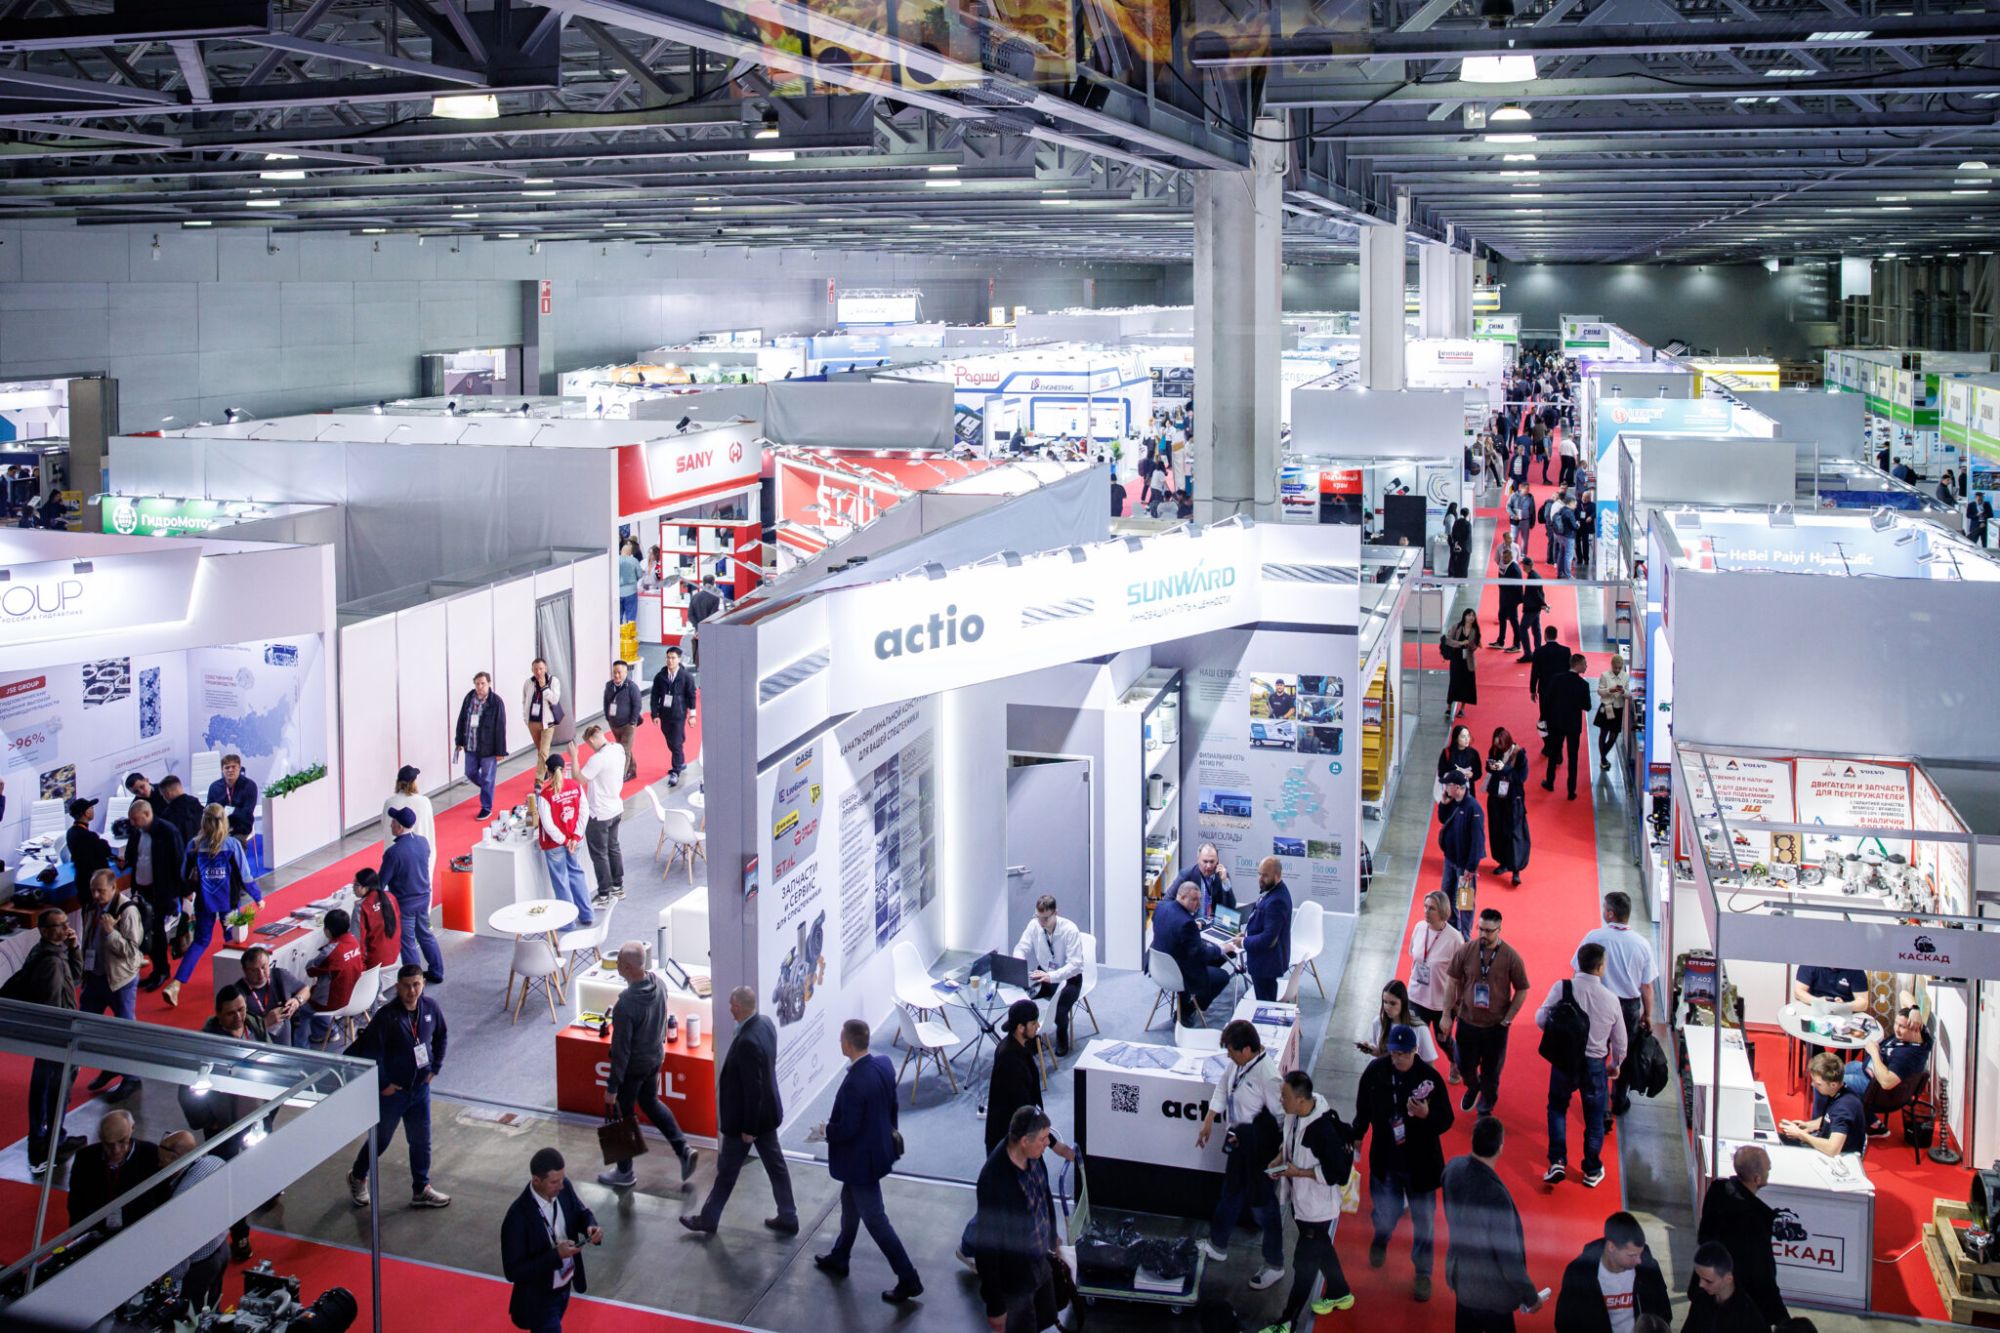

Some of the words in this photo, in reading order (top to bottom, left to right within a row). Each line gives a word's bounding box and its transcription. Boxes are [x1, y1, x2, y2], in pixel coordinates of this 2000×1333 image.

[676, 449, 713, 474] SANY
[1730, 549, 1768, 561] HeBei
[1773, 550, 1805, 566] Paiyi
[1127, 558, 1236, 606] SUNWARD
[874, 603, 985, 661] actio
[795, 747, 813, 767] CASE
[1811, 780, 1855, 790] ДВИГАТЕЛИ
[1815, 789, 1832, 797] ДЛЯ
[1834, 789, 1905, 800] ПЕРЕГРУЖАТЕЛЕЙ
[1867, 817, 1905, 826] НАЛИЧИИ
[782, 860, 818, 899] ЗАПЧАСТИ
[1898, 951, 1950, 964] КАСКАД
